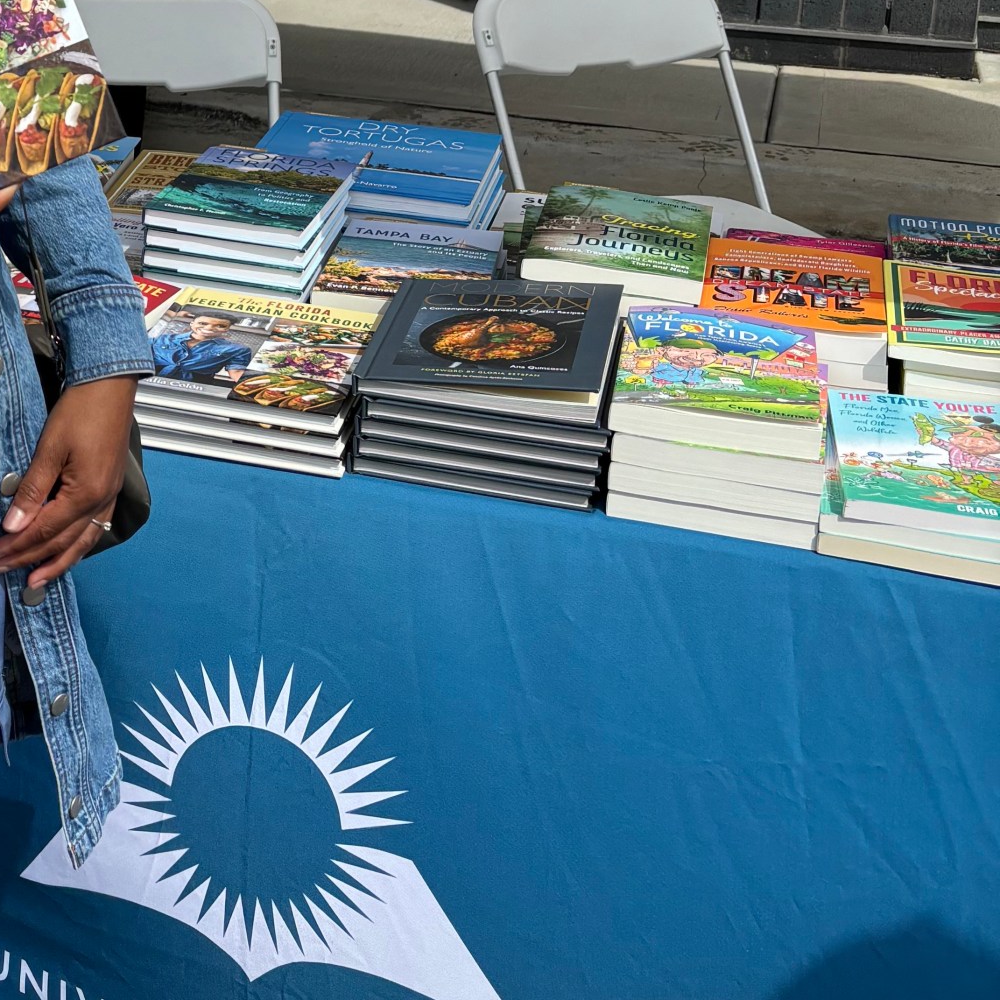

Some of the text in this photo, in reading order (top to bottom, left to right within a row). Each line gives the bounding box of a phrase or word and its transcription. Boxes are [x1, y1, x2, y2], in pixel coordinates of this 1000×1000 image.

[303, 125, 464, 150] TORTUGAS
[359, 122, 418, 134] DRY
[321, 137, 377, 148] Stronghold
[395, 145, 432, 153] Nature
[213, 156, 330, 177] SPRINGS
[221, 149, 335, 170] FLORIDA
[356, 227, 453, 242] TAMPA BAY
[601, 214, 699, 239] Tracing
[901, 218, 968, 232] MOTION
[567, 232, 694, 262] Journeys
[602, 225, 695, 251] Florida
[669, 266, 689, 274] Now
[712, 265, 870, 293] DREAM
[429, 282, 596, 297] MODERN
[712, 284, 866, 311] STATE
[267, 301, 331, 316] FLORIDA
[424, 293, 592, 311] CUBAN
[188, 297, 375, 330] VEGETARIAN COOKBOOK
[637, 313, 733, 328] Welcome to
[645, 321, 780, 347] FLORIDA
[728, 404, 762, 414] Craig
[839, 392, 997, 414] THE STATE YOU'RE
[956, 505, 998, 516] CRAIG
